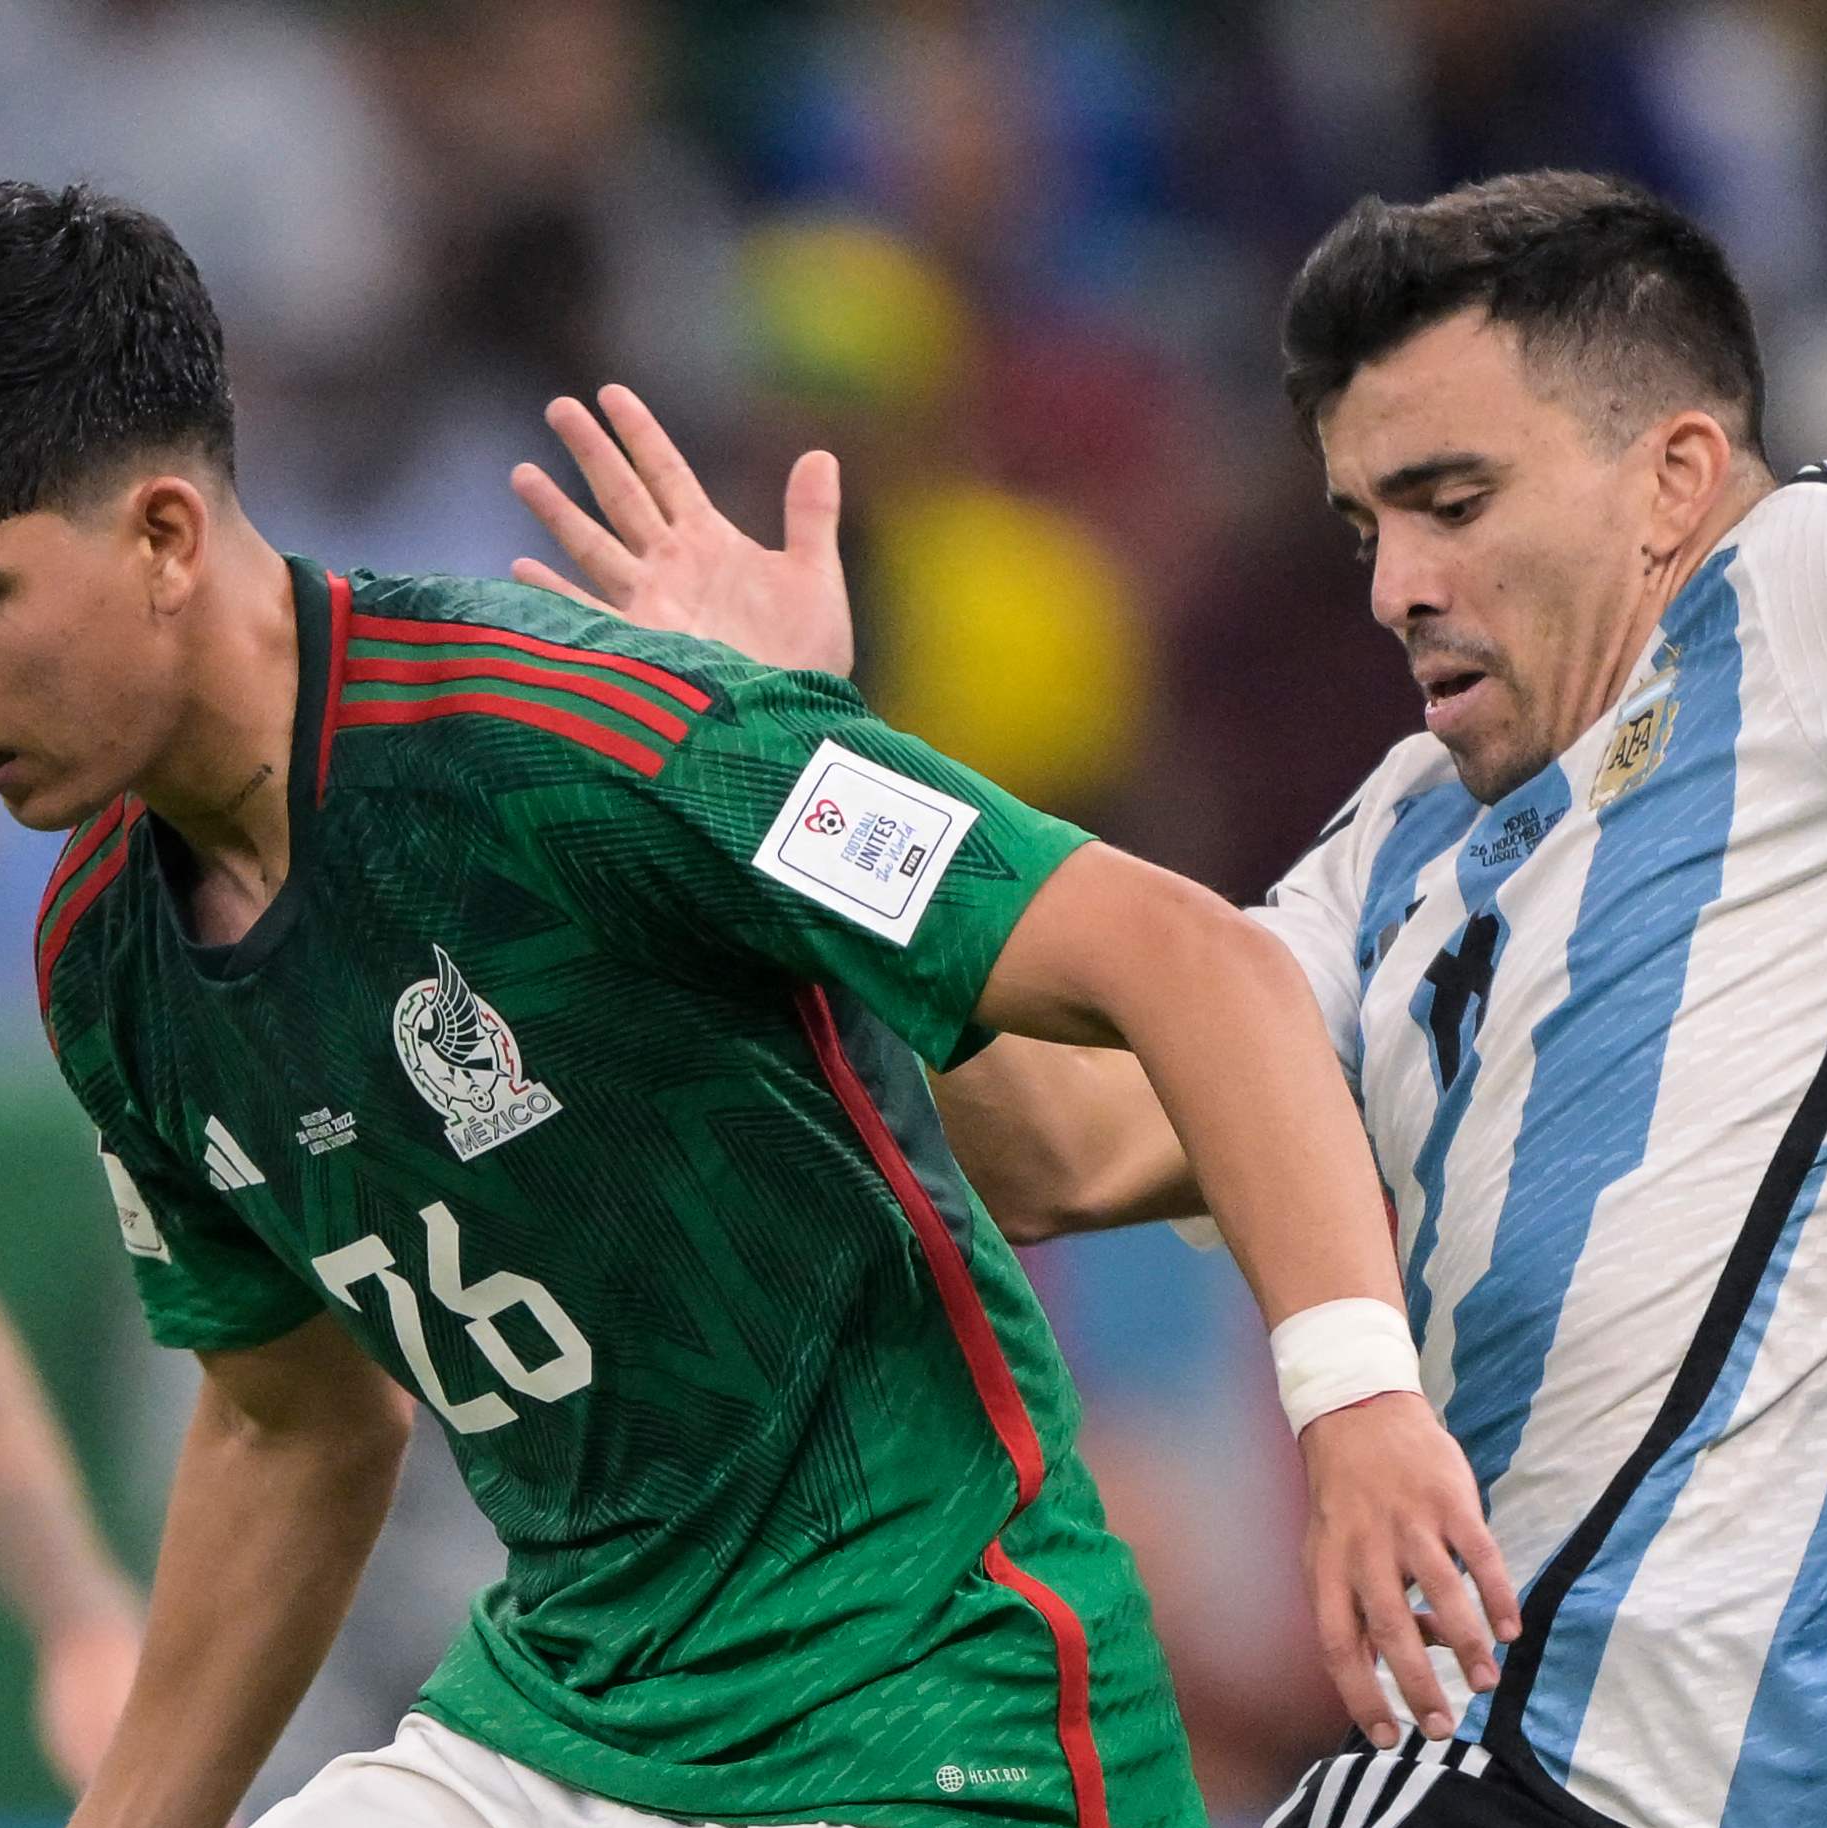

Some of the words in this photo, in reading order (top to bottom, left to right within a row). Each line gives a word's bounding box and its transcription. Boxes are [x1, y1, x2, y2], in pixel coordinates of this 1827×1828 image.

[1608, 709, 1654, 770] AFA
[840, 811, 878, 863] FOOTBALL
[855, 816, 897, 871] UNITES
[903, 847, 923, 874] FIFA
[1470, 844, 1488, 857] 26
[875, 859, 894, 883] the
[451, 1092, 552, 1155] MÉXICO
[311, 1201, 592, 1434] 26
